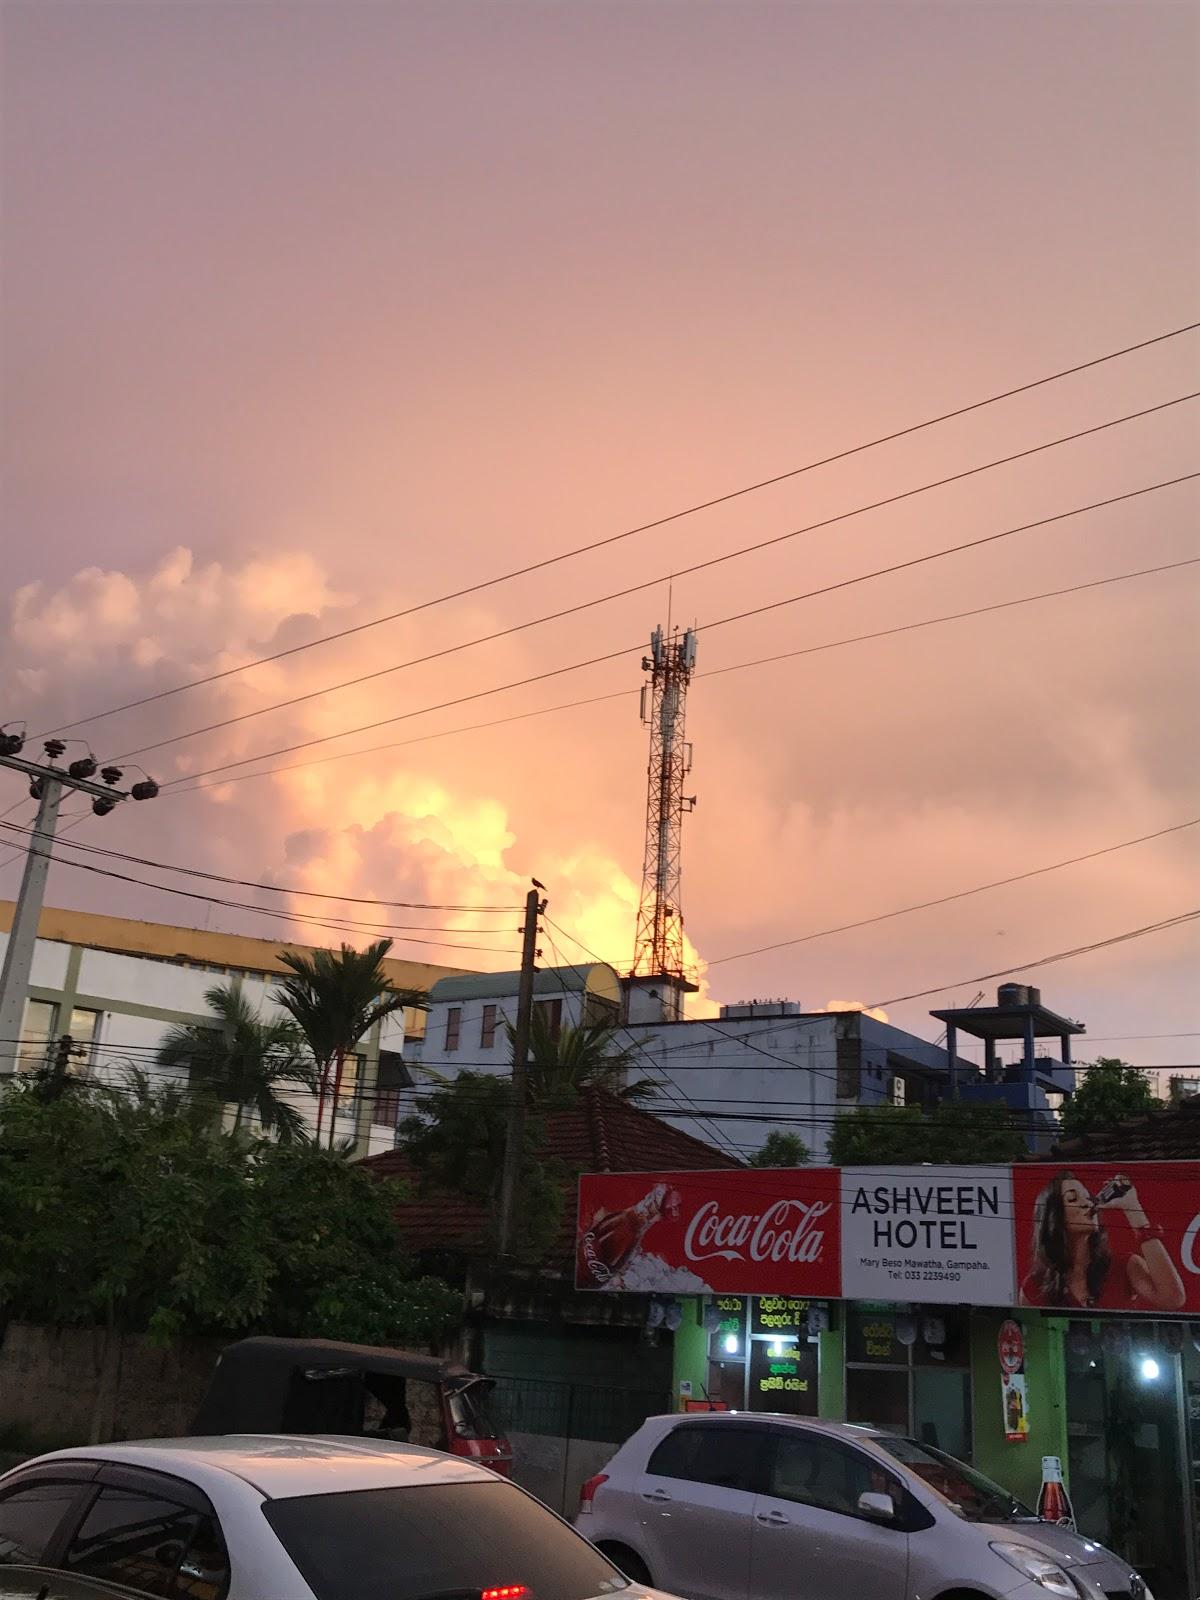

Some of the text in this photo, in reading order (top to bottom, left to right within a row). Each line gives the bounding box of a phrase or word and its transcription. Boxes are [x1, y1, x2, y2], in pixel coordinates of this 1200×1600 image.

[852, 1186, 998, 1214] ASHVEEN
[684, 1199, 832, 1263] Coca-Cola
[873, 1220, 977, 1249] HOTEL
[860, 1258, 880, 1269] Mary
[904, 1258, 944, 1269] Mawatha,
[946, 1260, 990, 1271] Gampaha.
[888, 1271, 961, 1281] Tel: 033 2239490
